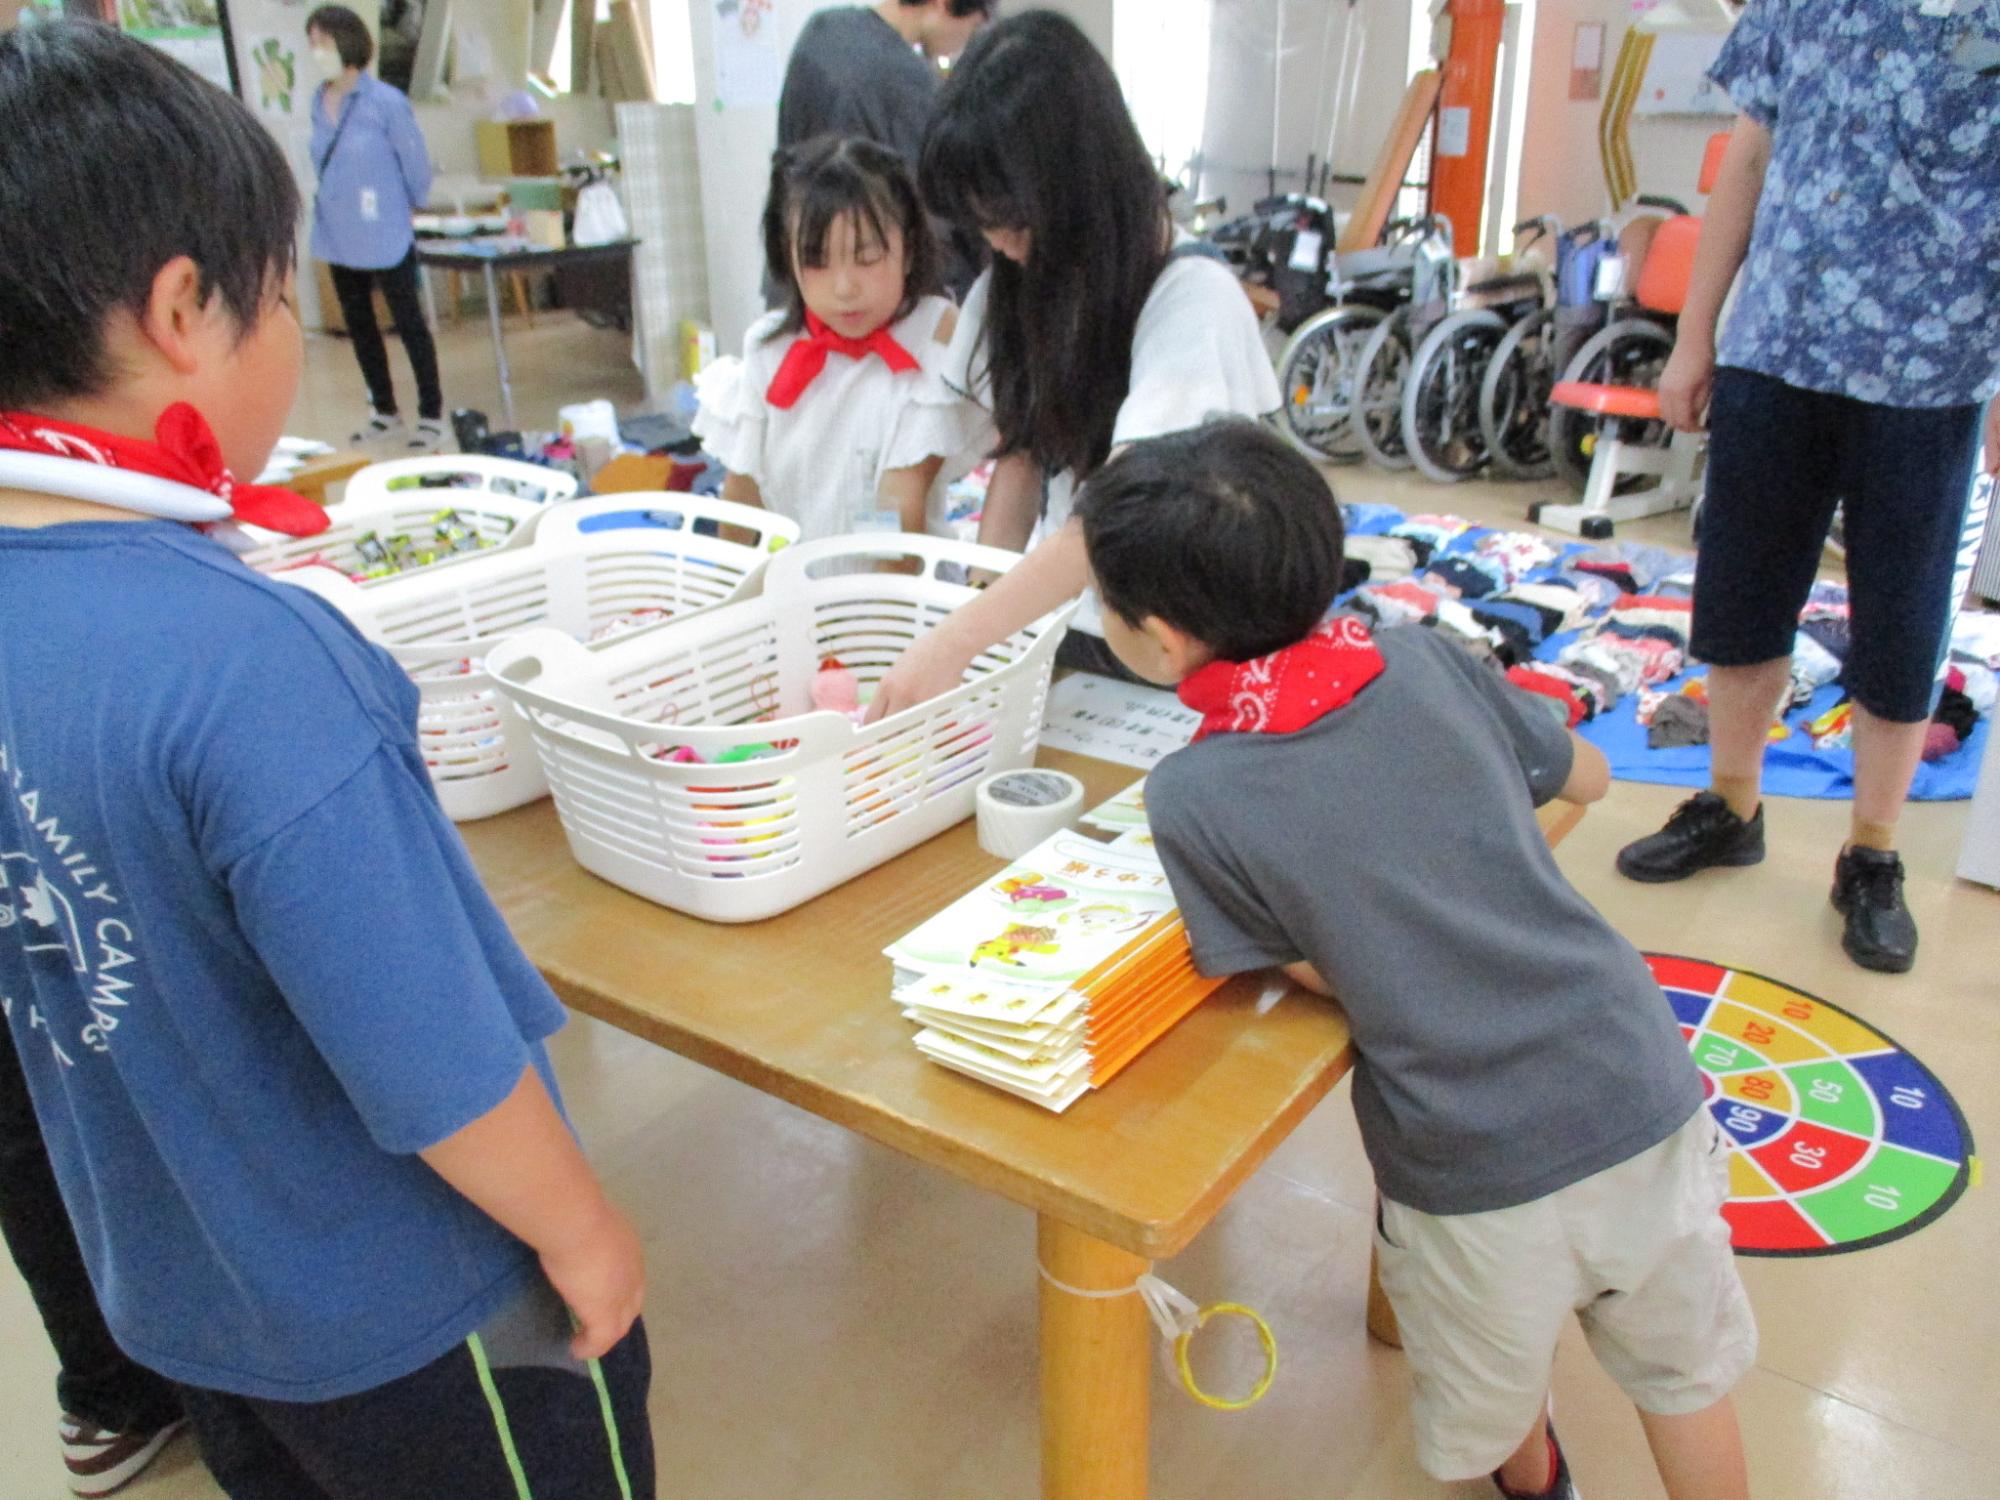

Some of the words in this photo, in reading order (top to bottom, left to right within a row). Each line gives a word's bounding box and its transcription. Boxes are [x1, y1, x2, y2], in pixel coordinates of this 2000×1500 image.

[1782, 1000, 1814, 1021] 10
[1742, 1022, 1776, 1045] 20
[1704, 1044, 1739, 1067] 70
[1739, 1075, 1775, 1101] 80
[1807, 1078, 1843, 1104] 50
[1889, 1085, 1926, 1110] 10
[1724, 1105, 1763, 1133] 90
[1789, 1140, 1827, 1170] 30
[1863, 1184, 1903, 1211] 10
